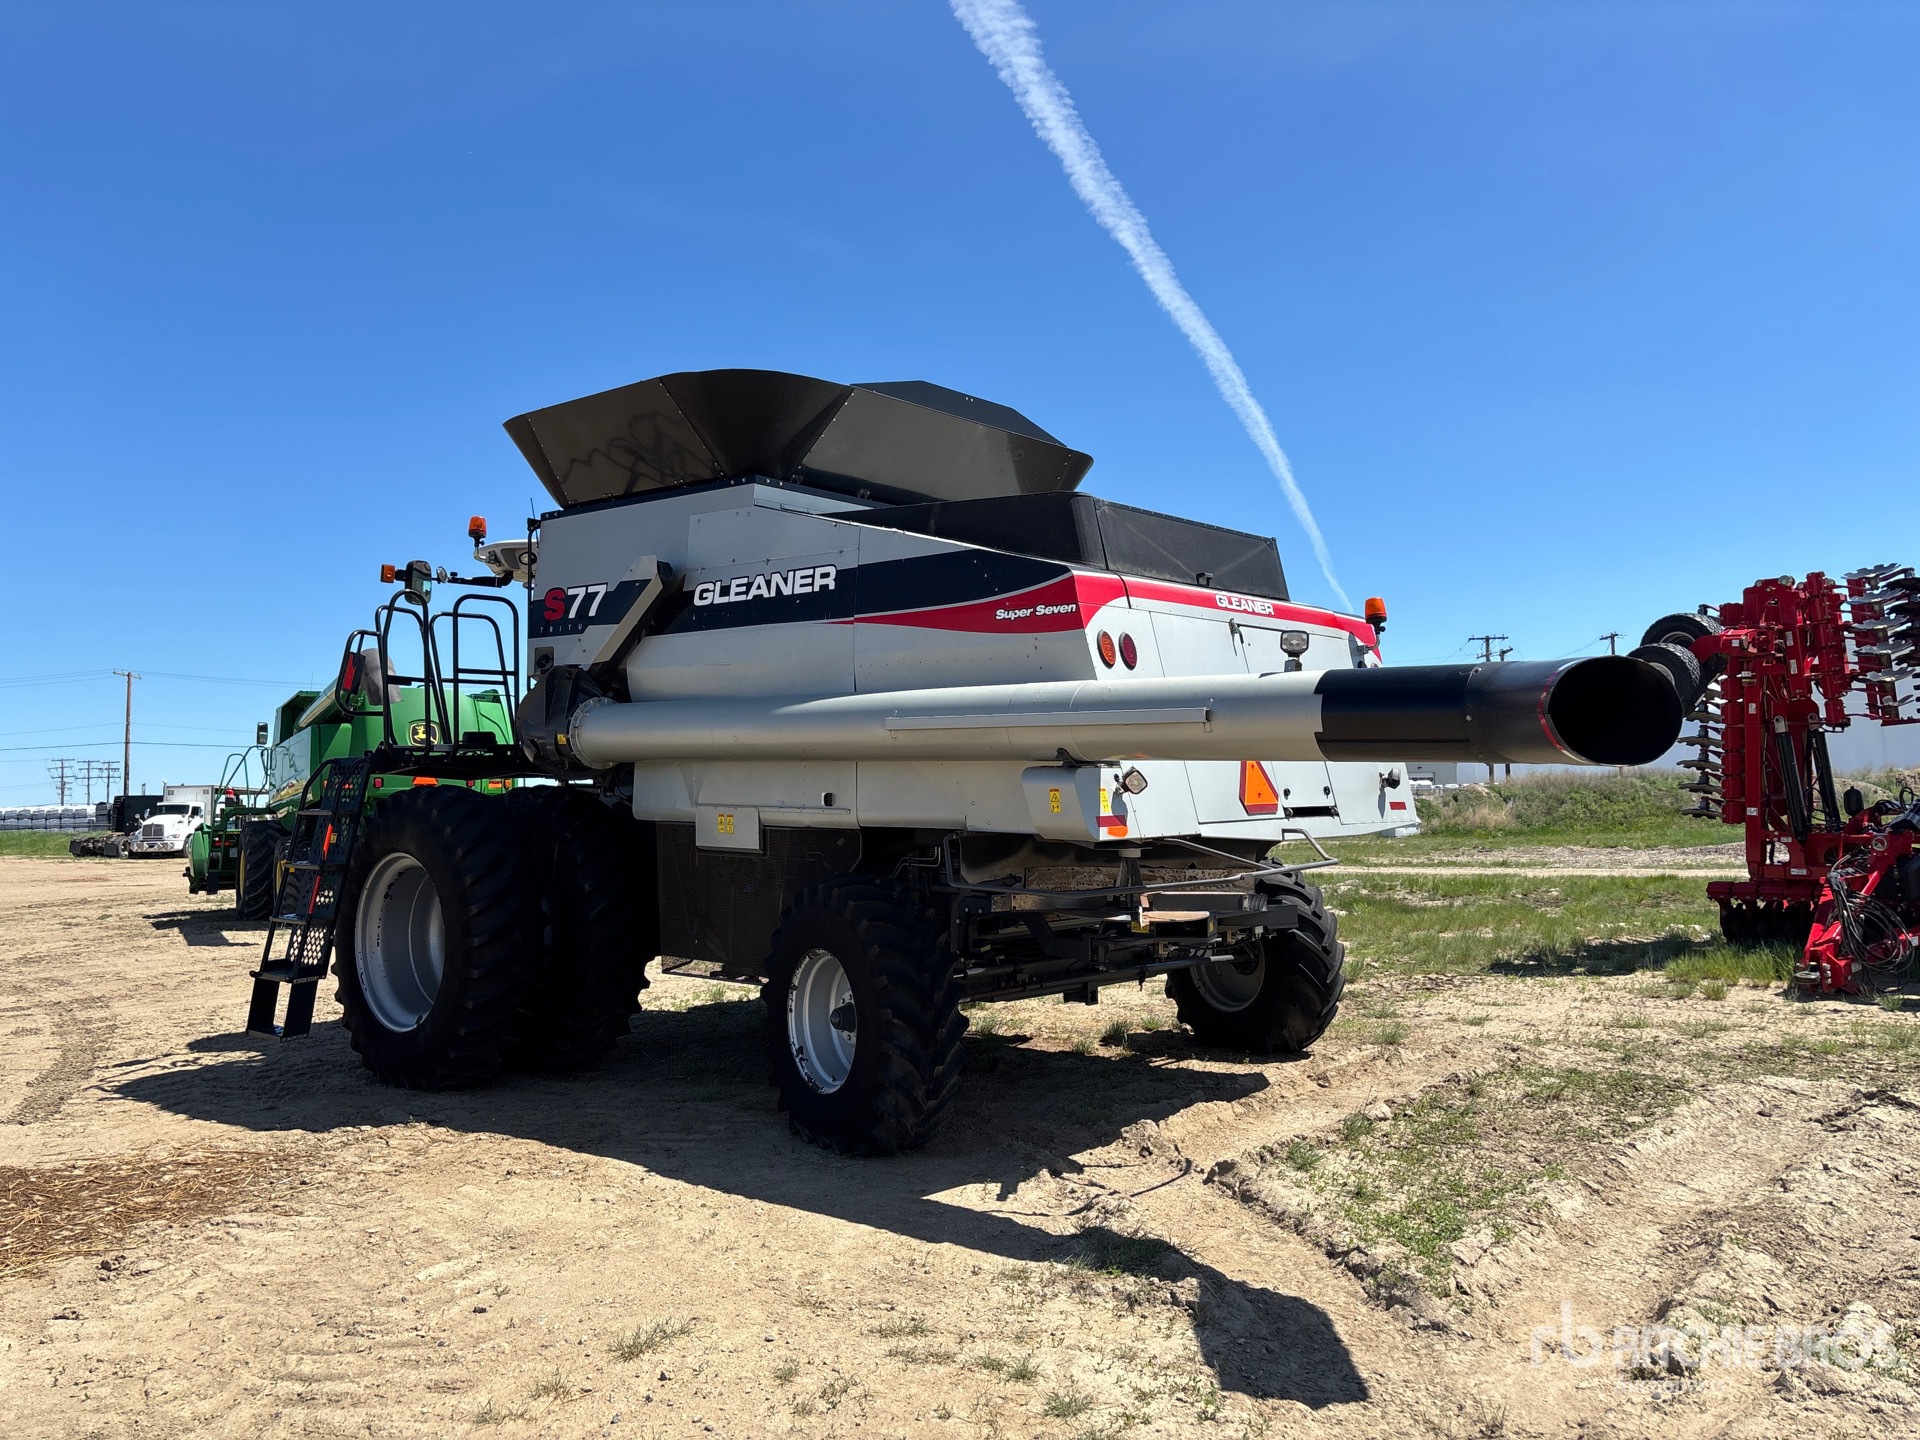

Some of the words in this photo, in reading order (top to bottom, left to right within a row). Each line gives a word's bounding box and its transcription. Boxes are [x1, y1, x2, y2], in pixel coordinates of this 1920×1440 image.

[693, 565, 837, 606] GLEANER
[543, 584, 608, 621] S77
[996, 608, 1034, 621] Super
[1035, 604, 1077, 616] Seven
[1215, 594, 1275, 616] GLEANER
